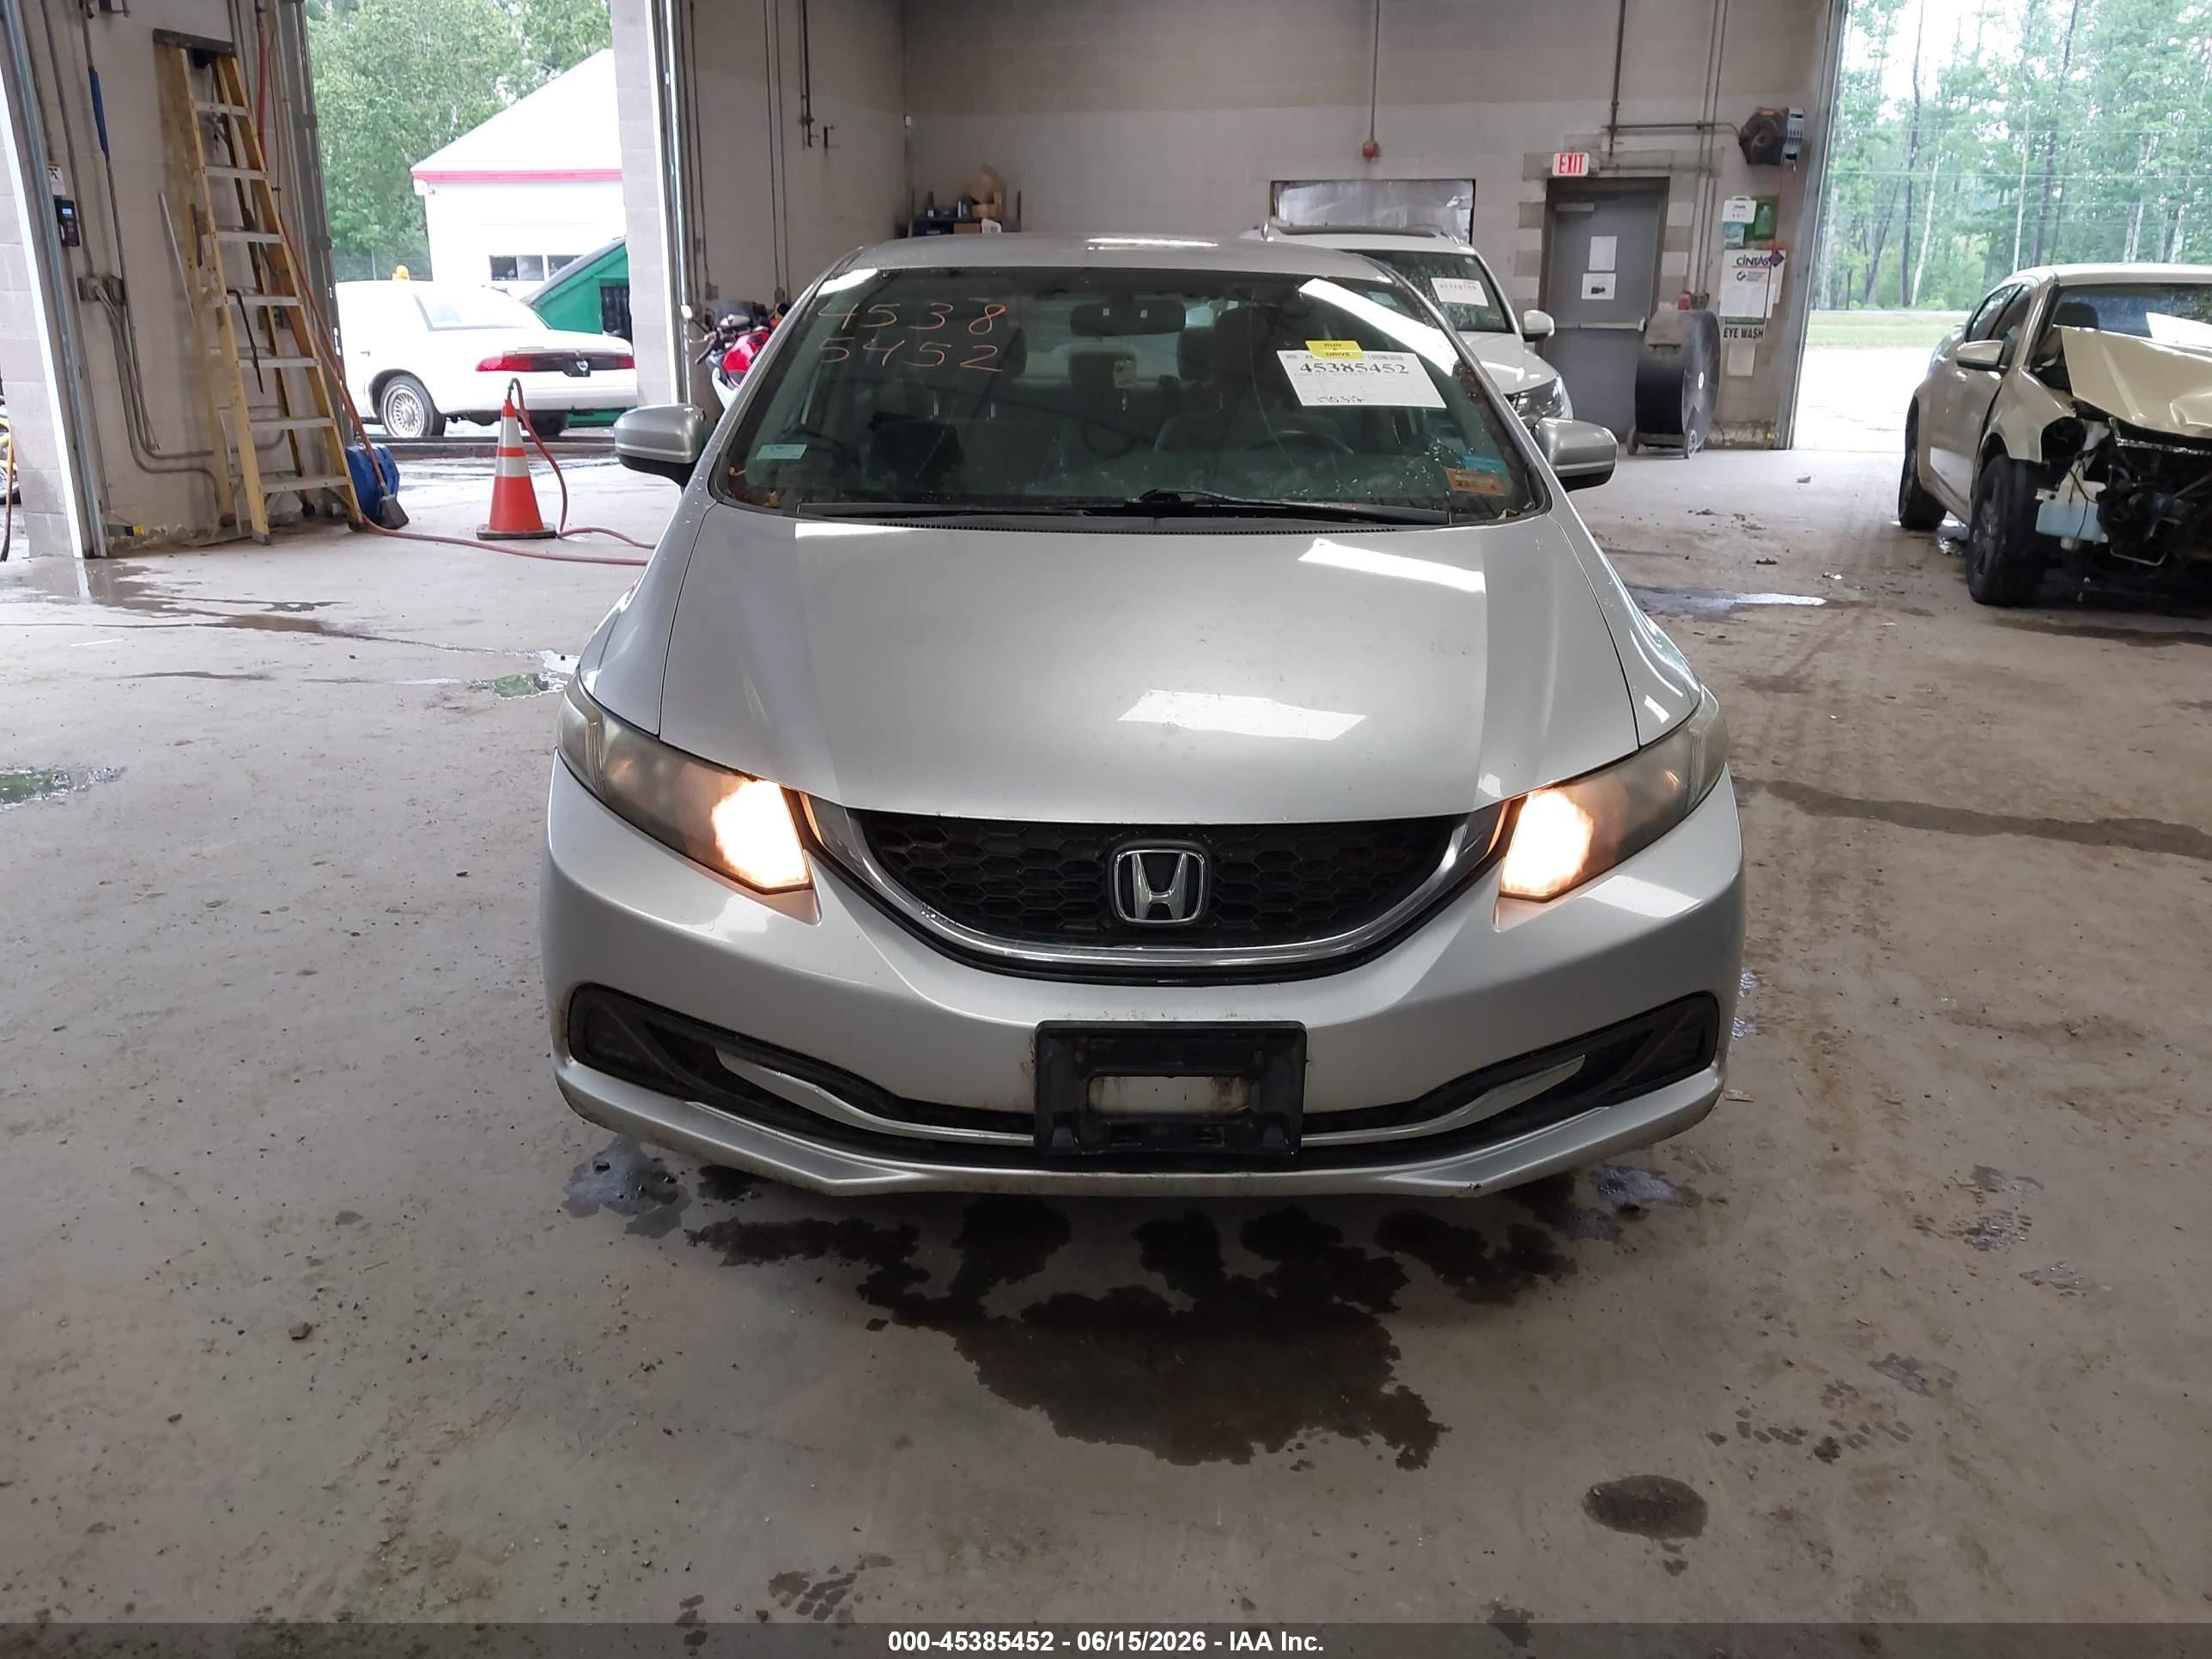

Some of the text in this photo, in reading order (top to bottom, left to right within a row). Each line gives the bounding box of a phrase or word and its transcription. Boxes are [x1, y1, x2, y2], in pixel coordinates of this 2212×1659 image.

[1559, 154, 1585, 173] EXIT
[1723, 327, 1765, 339] EYE WASH
[1299, 362, 1409, 374] 45385452
